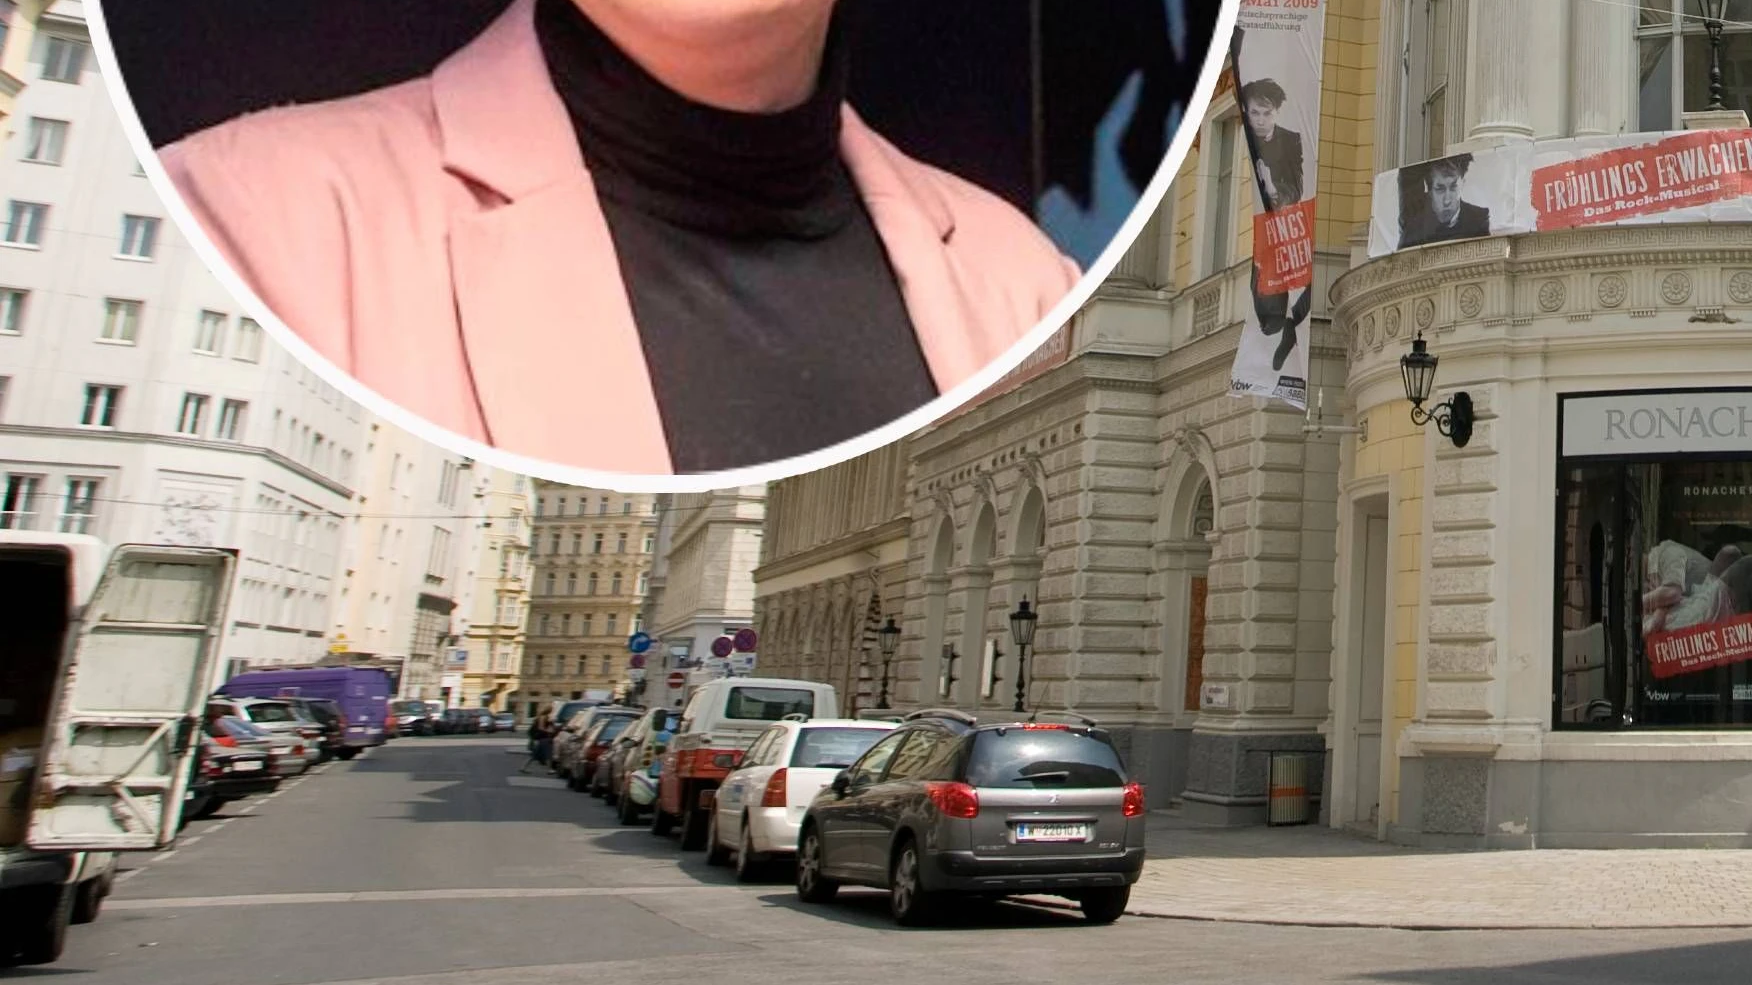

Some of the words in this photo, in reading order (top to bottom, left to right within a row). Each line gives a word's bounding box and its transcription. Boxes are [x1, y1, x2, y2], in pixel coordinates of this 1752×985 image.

[1544, 160, 1648, 213] FRÜHLINGS
[1583, 205, 1612, 217] Das
[1614, 180, 1721, 211] Rock-Musical
[1655, 630, 1719, 664] FRÜHLINGS
[1649, 690, 1670, 701] vbw
